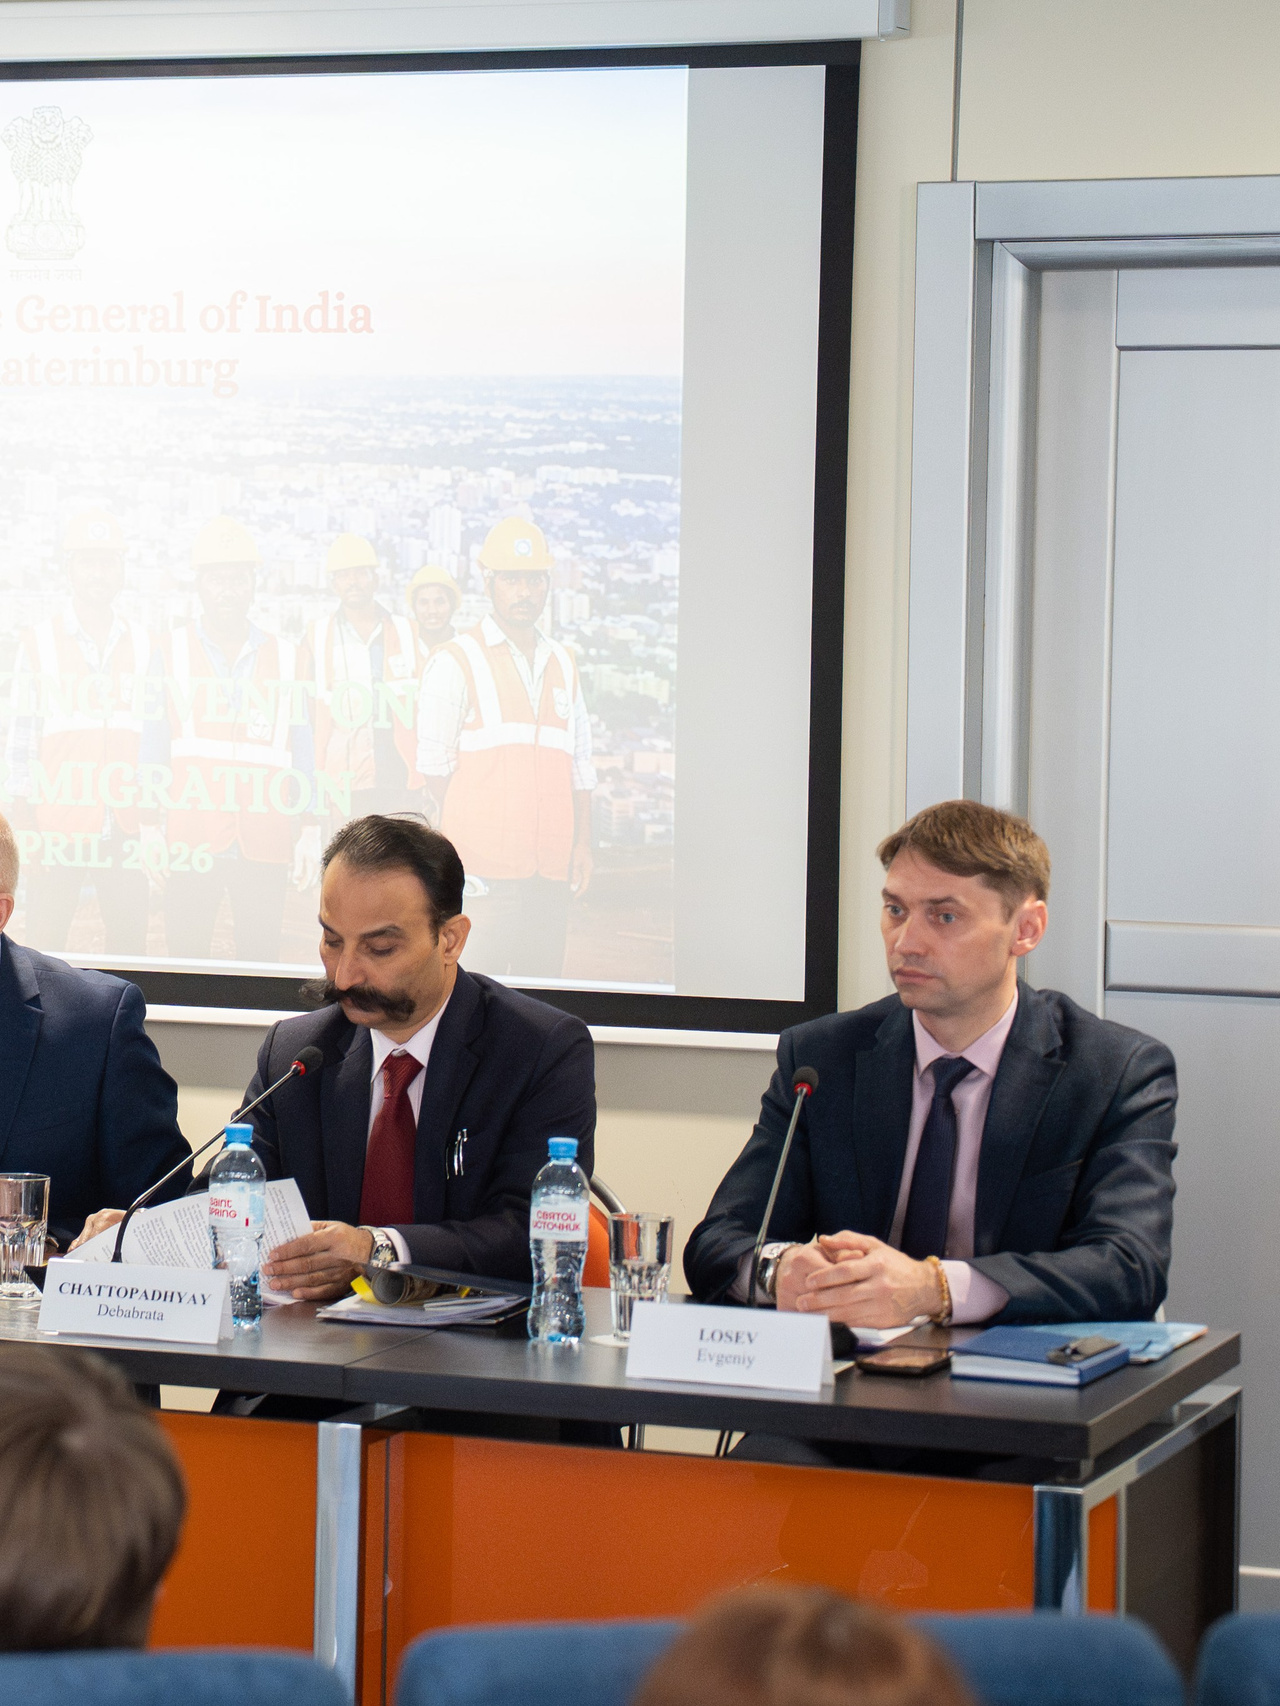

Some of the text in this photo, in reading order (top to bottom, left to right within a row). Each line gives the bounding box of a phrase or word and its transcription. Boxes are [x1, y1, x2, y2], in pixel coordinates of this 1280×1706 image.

[15, 291, 188, 335] General
[199, 289, 248, 334] of
[255, 290, 375, 335] India
[127, 674, 310, 727] EVENT
[332, 680, 418, 731] ON
[26, 760, 356, 816] MIGRATION
[15, 830, 214, 875] PRIL 2026
[58, 1281, 212, 1306] CHATTOPADHYAY
[97, 1303, 164, 1321] Debabrata
[699, 1328, 758, 1344] LOSEV
[697, 1348, 755, 1369] Evgeniy
